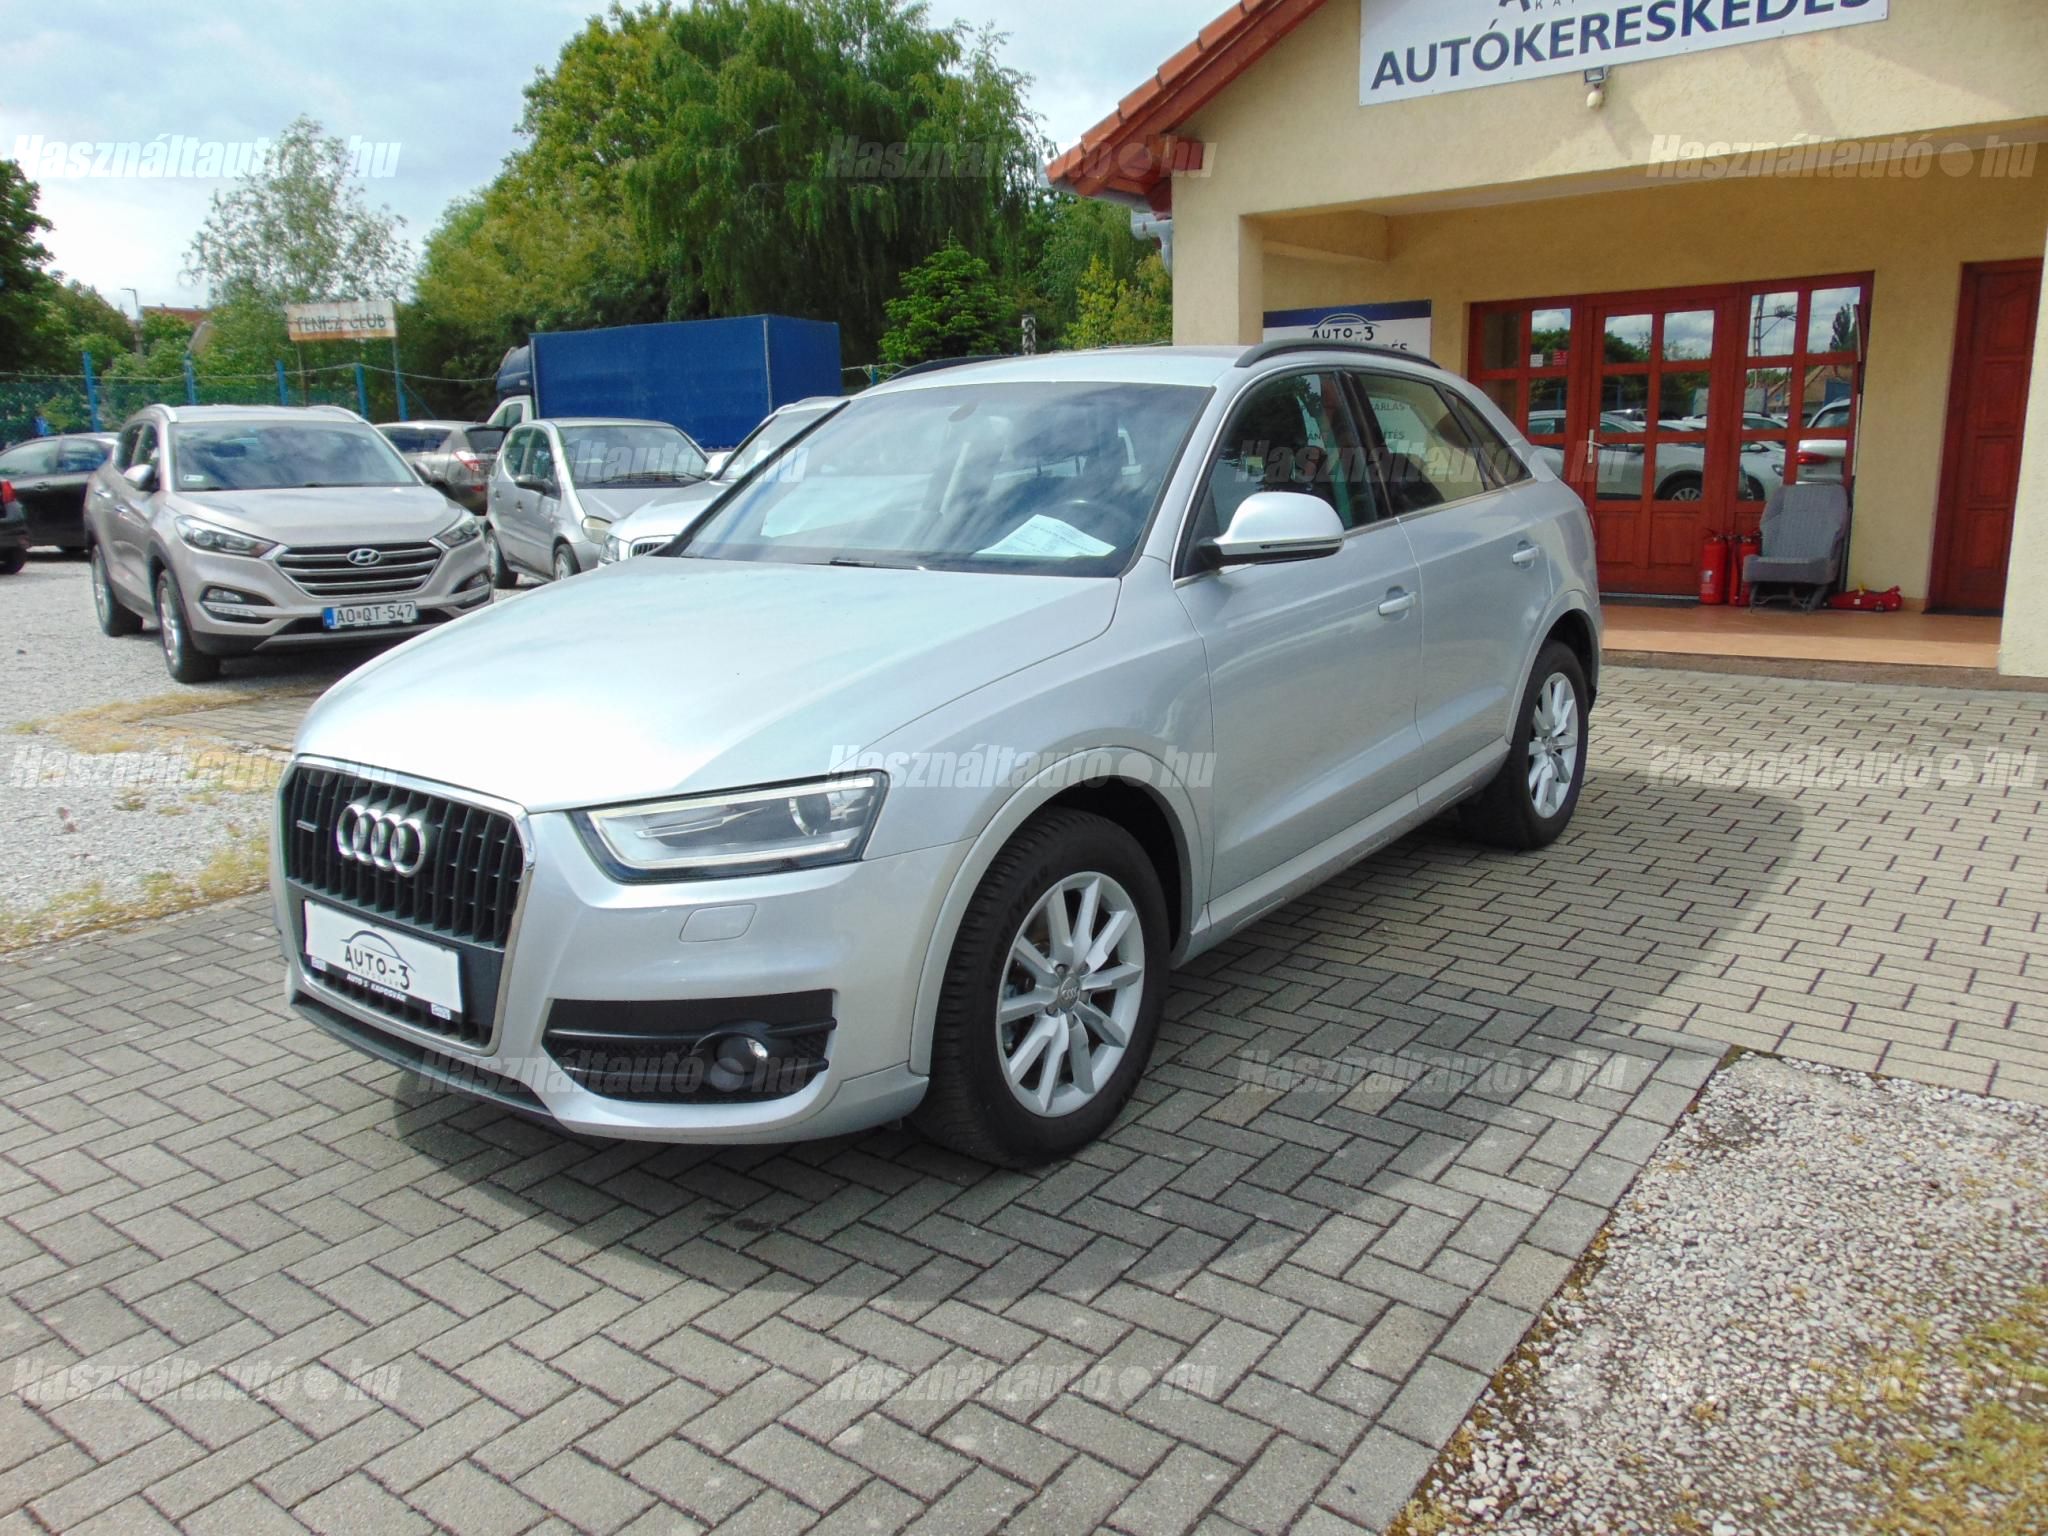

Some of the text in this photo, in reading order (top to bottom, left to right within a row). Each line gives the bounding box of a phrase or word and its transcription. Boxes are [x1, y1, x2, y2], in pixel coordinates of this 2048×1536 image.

[1371, 0, 1873, 90] AUTÓKERESKED
[350, 313, 386, 329] CLUB
[1312, 326, 1374, 341] AUTO-3
[344, 944, 410, 990] AUTO-3
